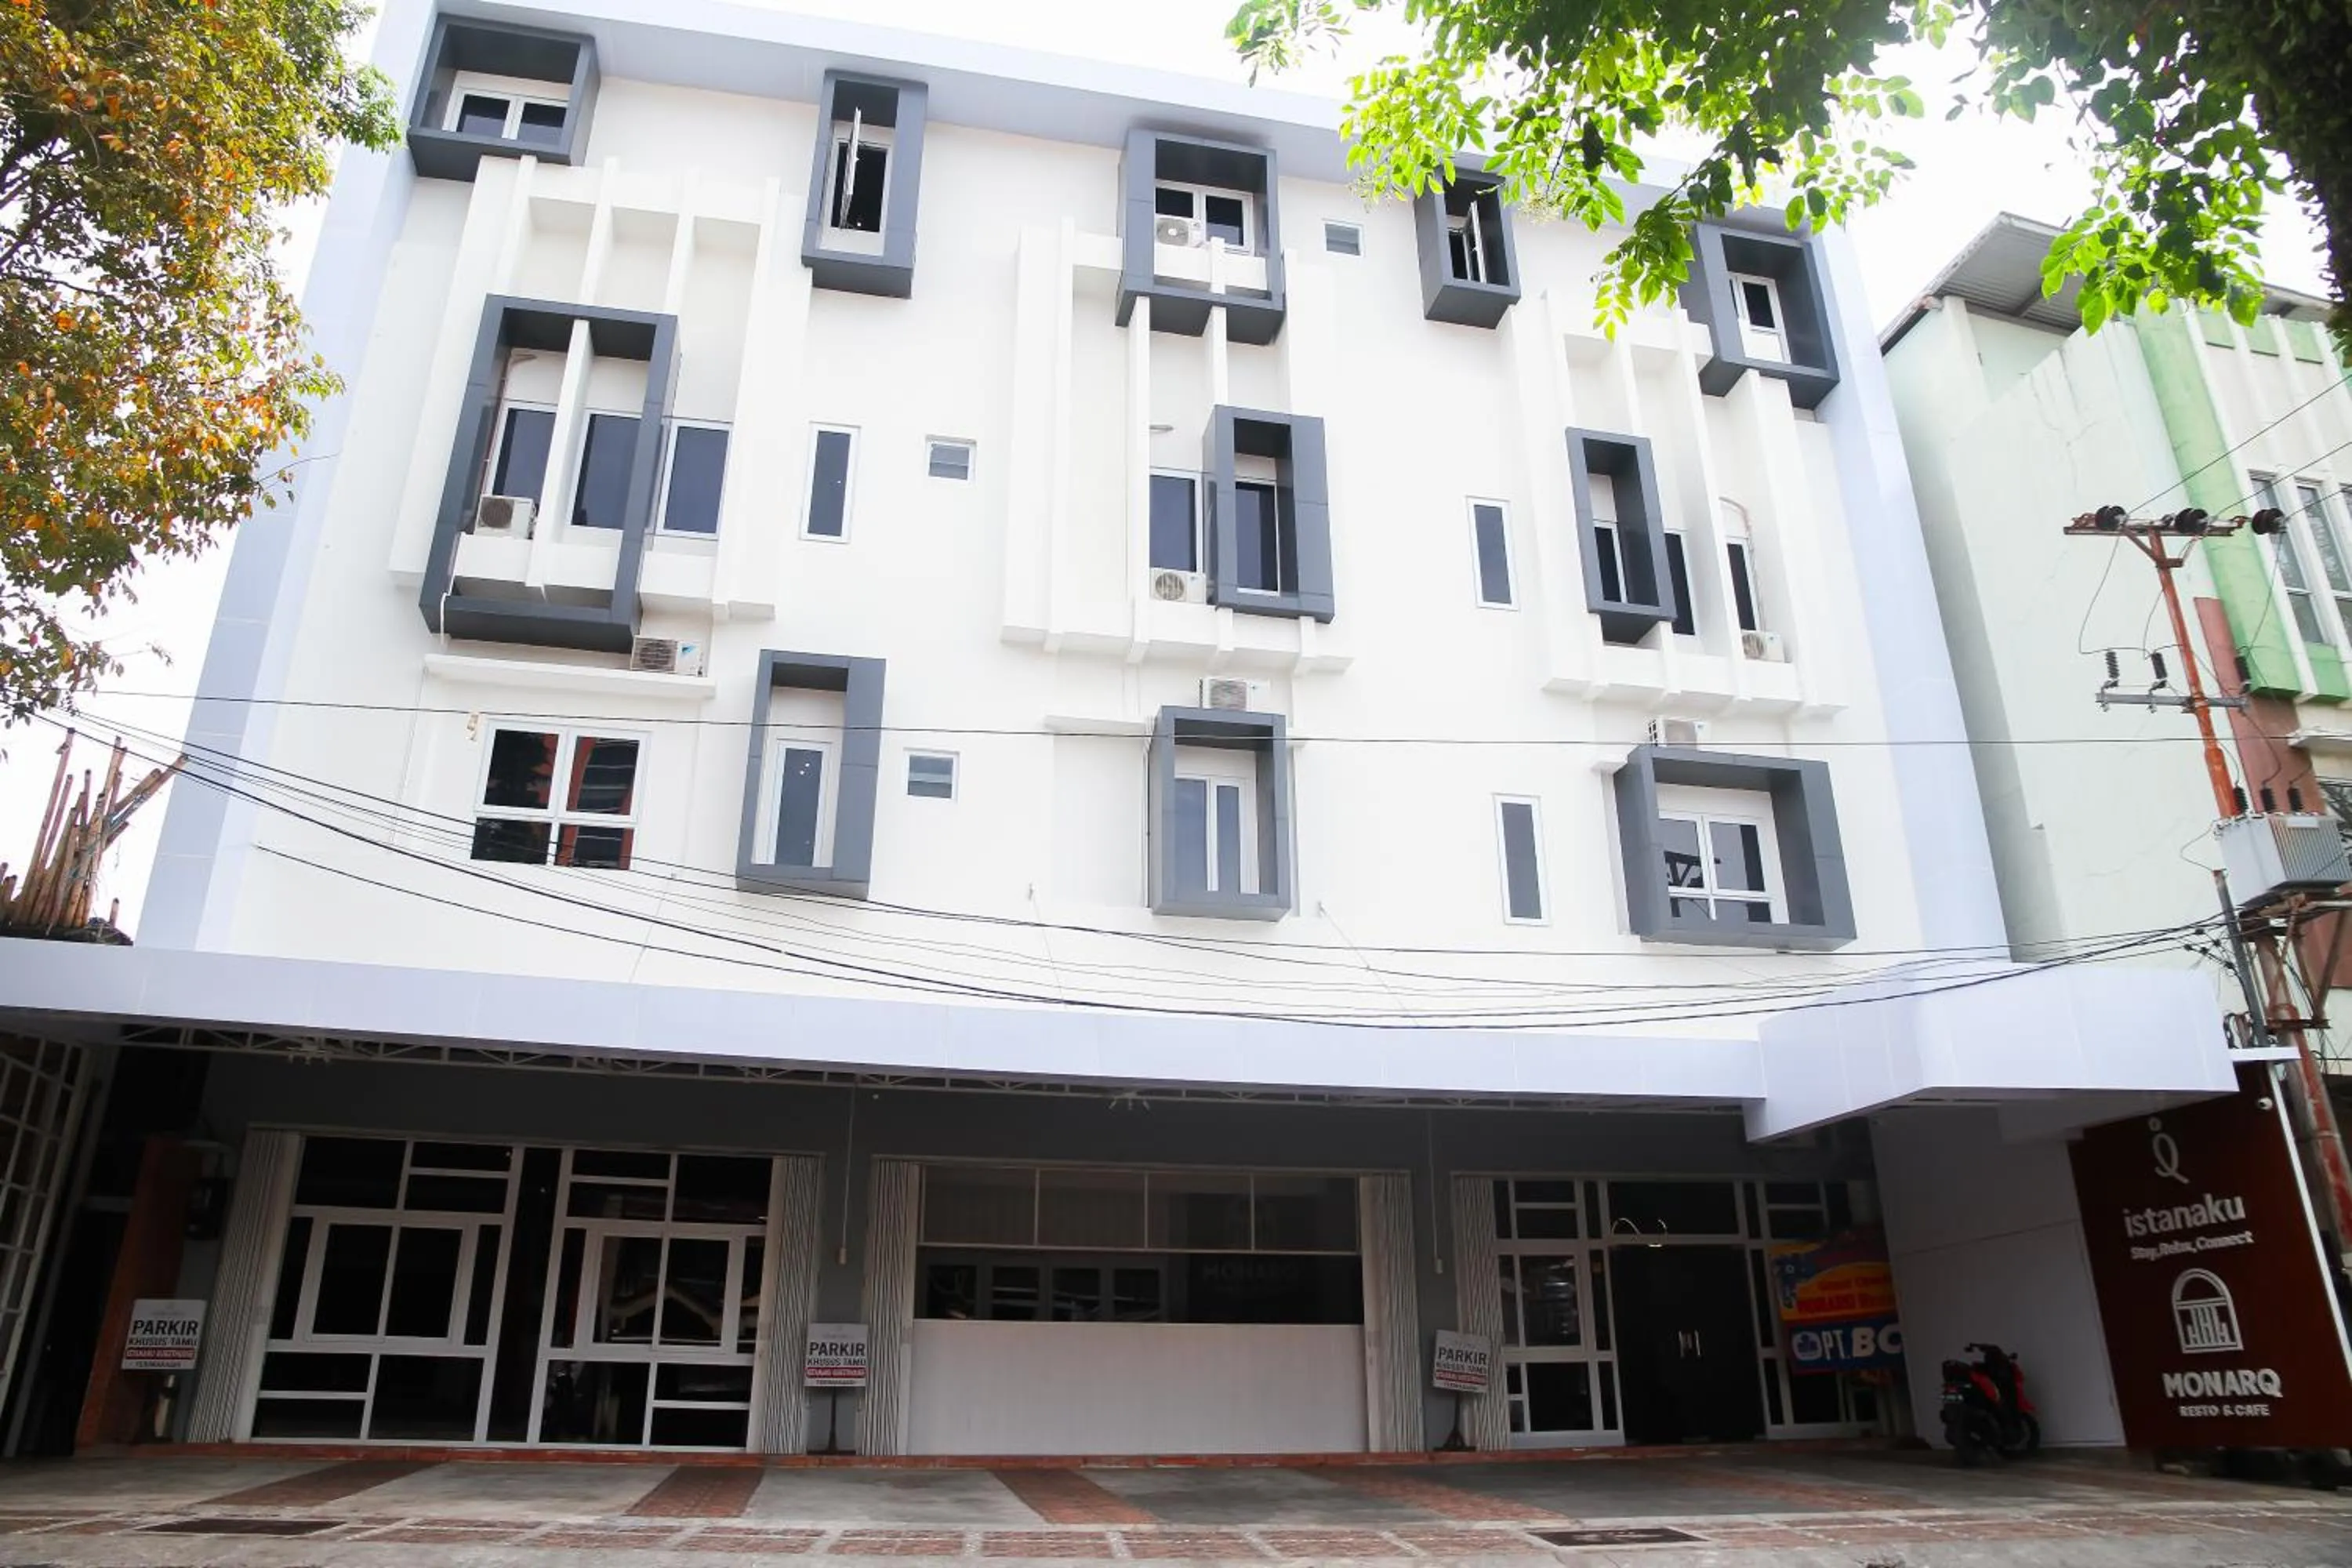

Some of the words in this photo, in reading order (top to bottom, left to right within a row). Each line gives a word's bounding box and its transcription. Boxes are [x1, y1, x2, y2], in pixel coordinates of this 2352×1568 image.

[2122, 1193, 2246, 1237] istanaku
[132, 1319, 199, 1335] PARKIR
[809, 1341, 866, 1356] PARKIR
[1438, 1346, 1488, 1365] PARKIR
[2162, 1368, 2284, 1398] MONARQ
[2179, 1404, 2219, 1417] RESTO
[2234, 1404, 2270, 1417] CAFE
